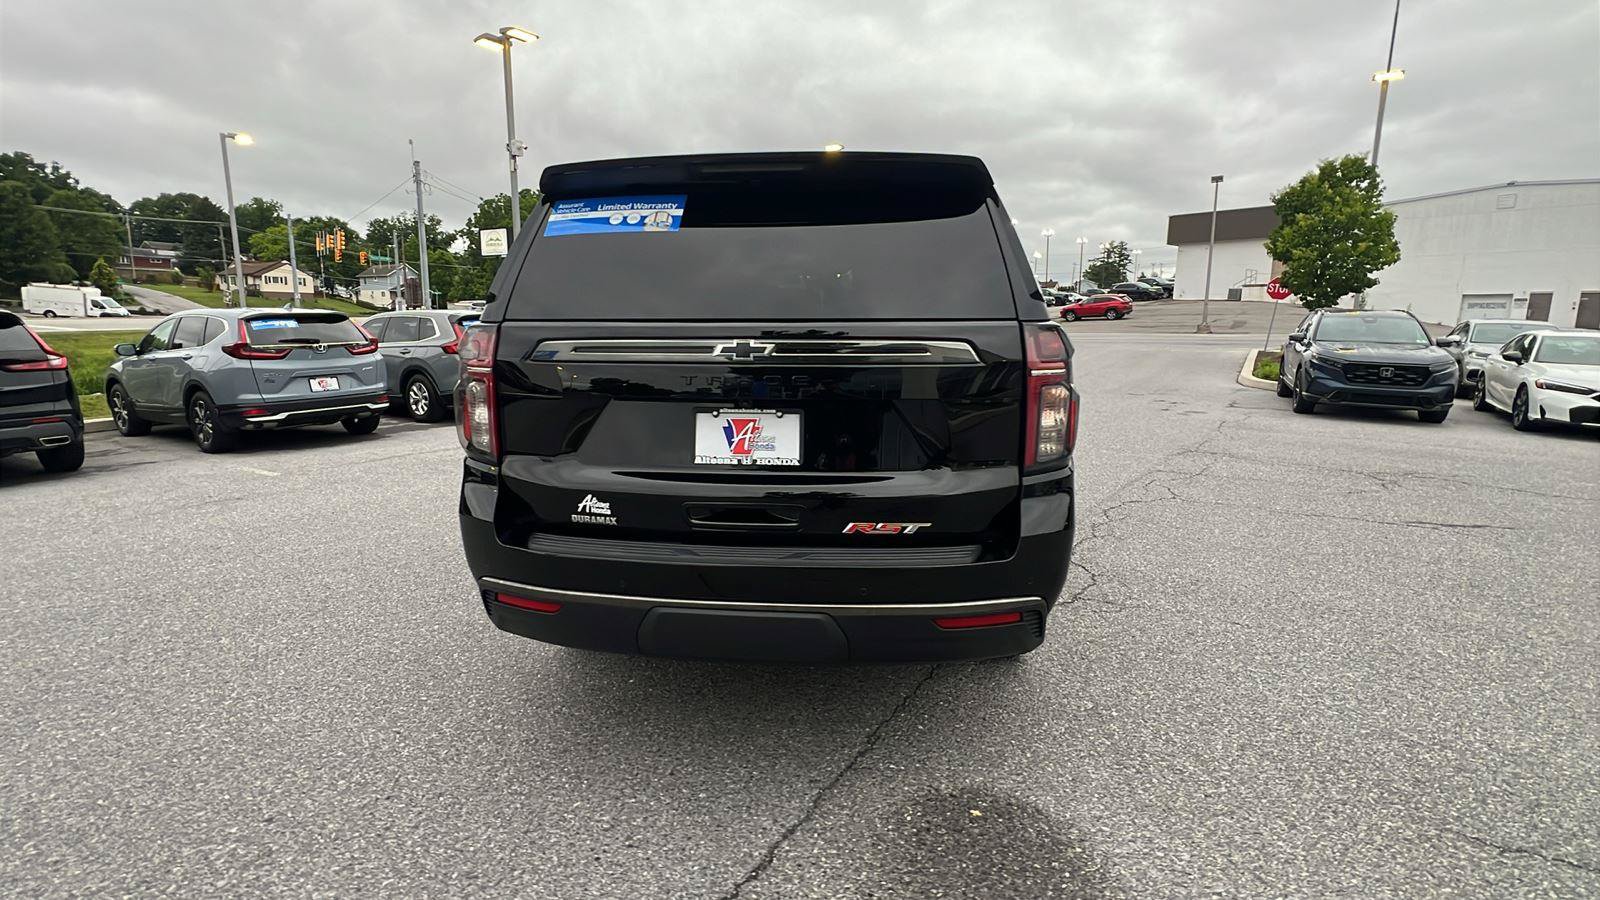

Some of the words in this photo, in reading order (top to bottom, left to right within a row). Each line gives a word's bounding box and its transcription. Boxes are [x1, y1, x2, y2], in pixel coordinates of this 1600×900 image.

[597, 202, 632, 211] Limited
[633, 202, 678, 210] Warranty
[694, 455, 739, 465] Altoona
[755, 458, 801, 466] HONDA
[571, 514, 618, 526] DURAMAX
[842, 522, 932, 534] RST
